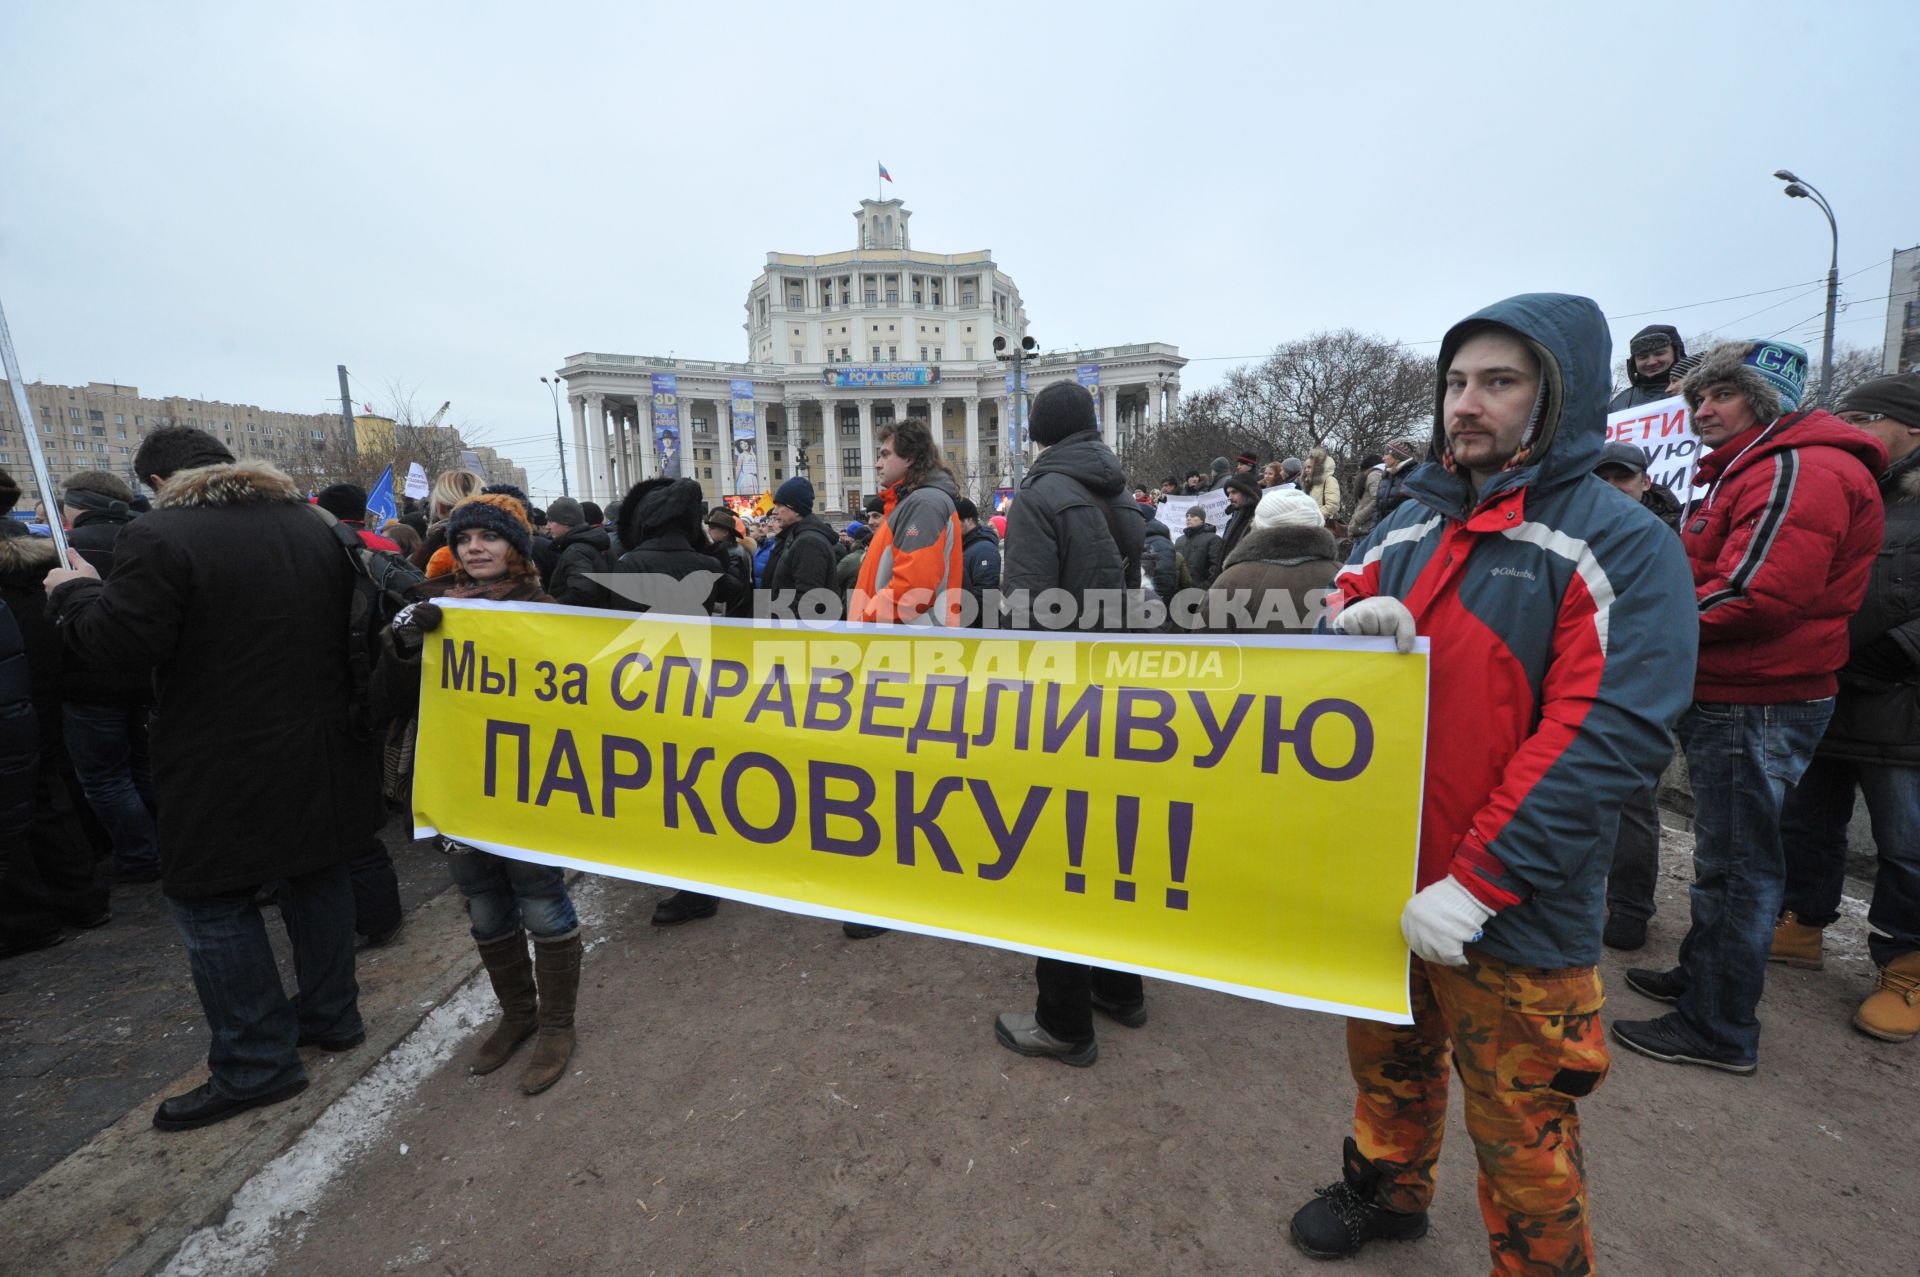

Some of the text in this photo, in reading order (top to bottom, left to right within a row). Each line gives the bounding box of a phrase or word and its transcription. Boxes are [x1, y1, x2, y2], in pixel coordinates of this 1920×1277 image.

[849, 371, 916, 382] POLA NEGRI
[655, 393, 676, 405] 3D
[655, 412, 677, 420] POLA
[1499, 567, 1536, 582] Columbia
[441, 638, 1375, 782] Мы за СПРАВЕДЛИВУЮ
[484, 719, 1194, 912] ПАРКОВКУ!!!
